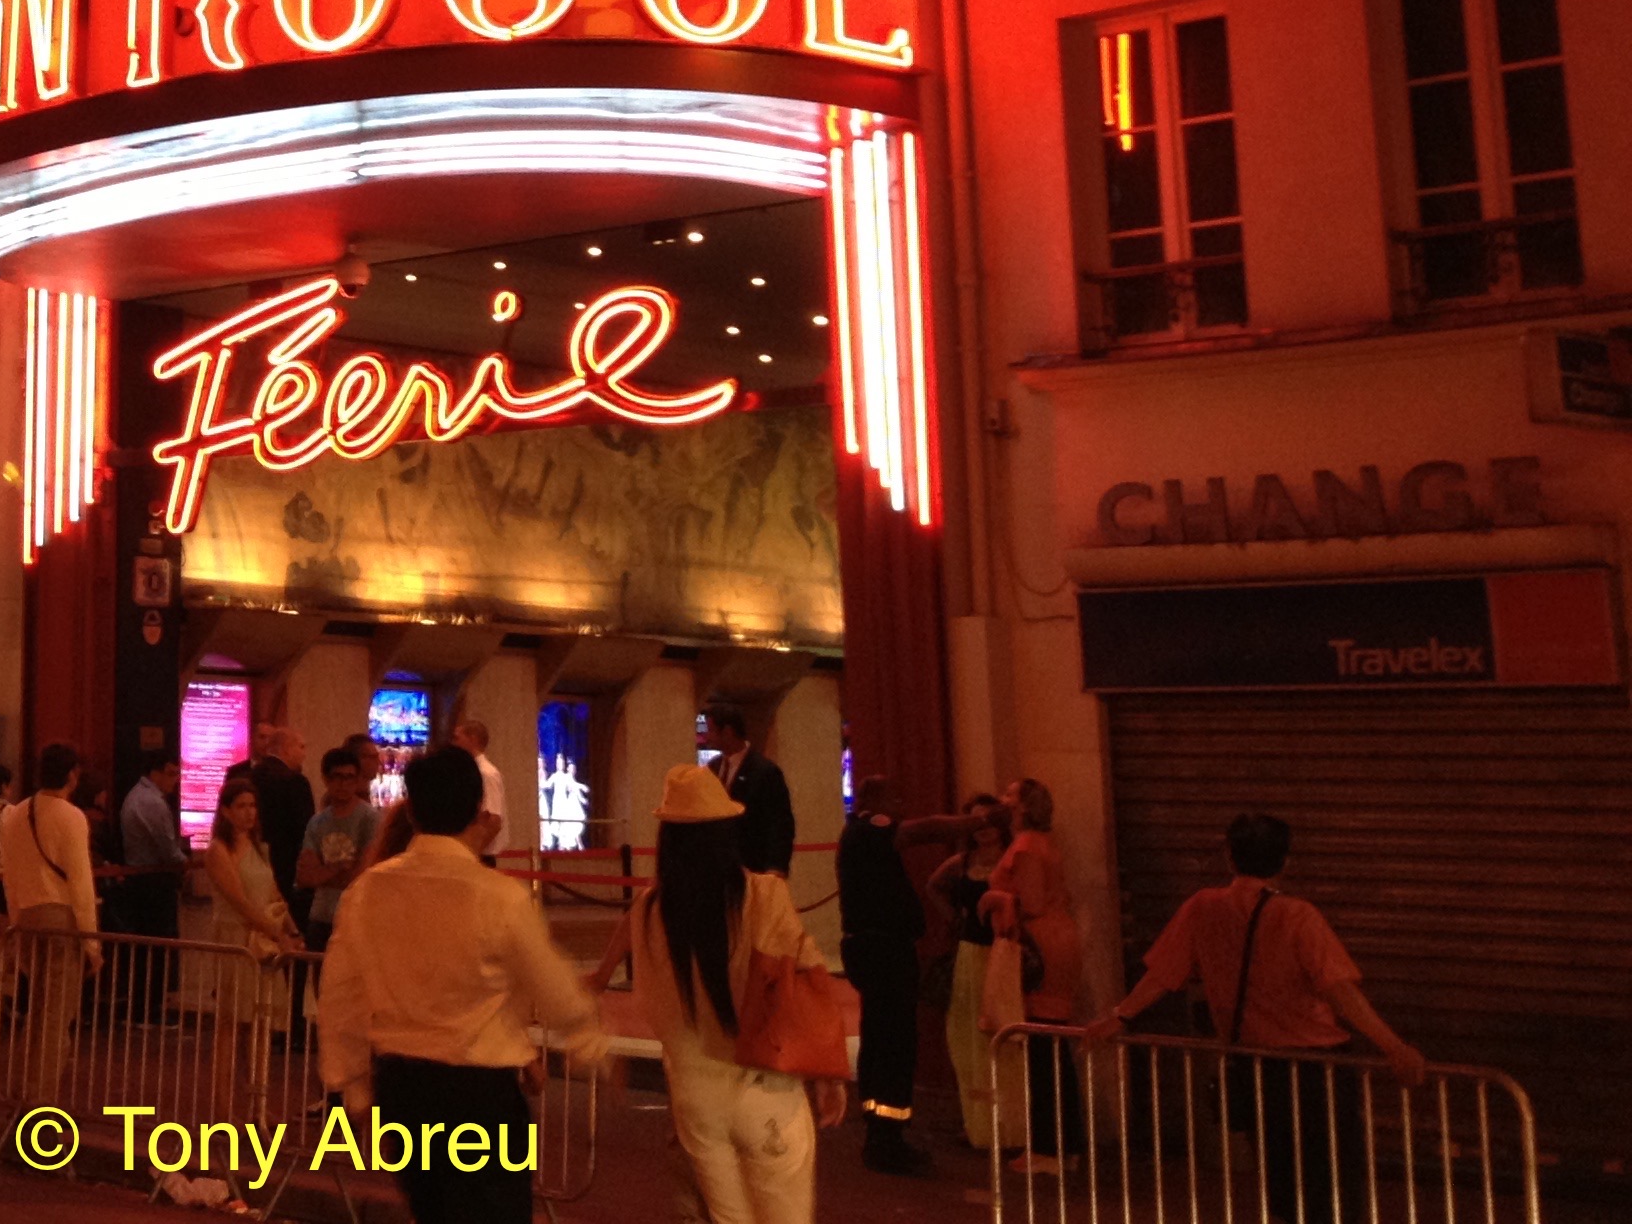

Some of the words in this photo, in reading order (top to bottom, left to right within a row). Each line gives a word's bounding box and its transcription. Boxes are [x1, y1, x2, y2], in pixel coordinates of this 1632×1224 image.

[153, 275, 740, 535] Féerie
[1095, 456, 1548, 546] CHANGE
[1328, 636, 1485, 677] Travelex
